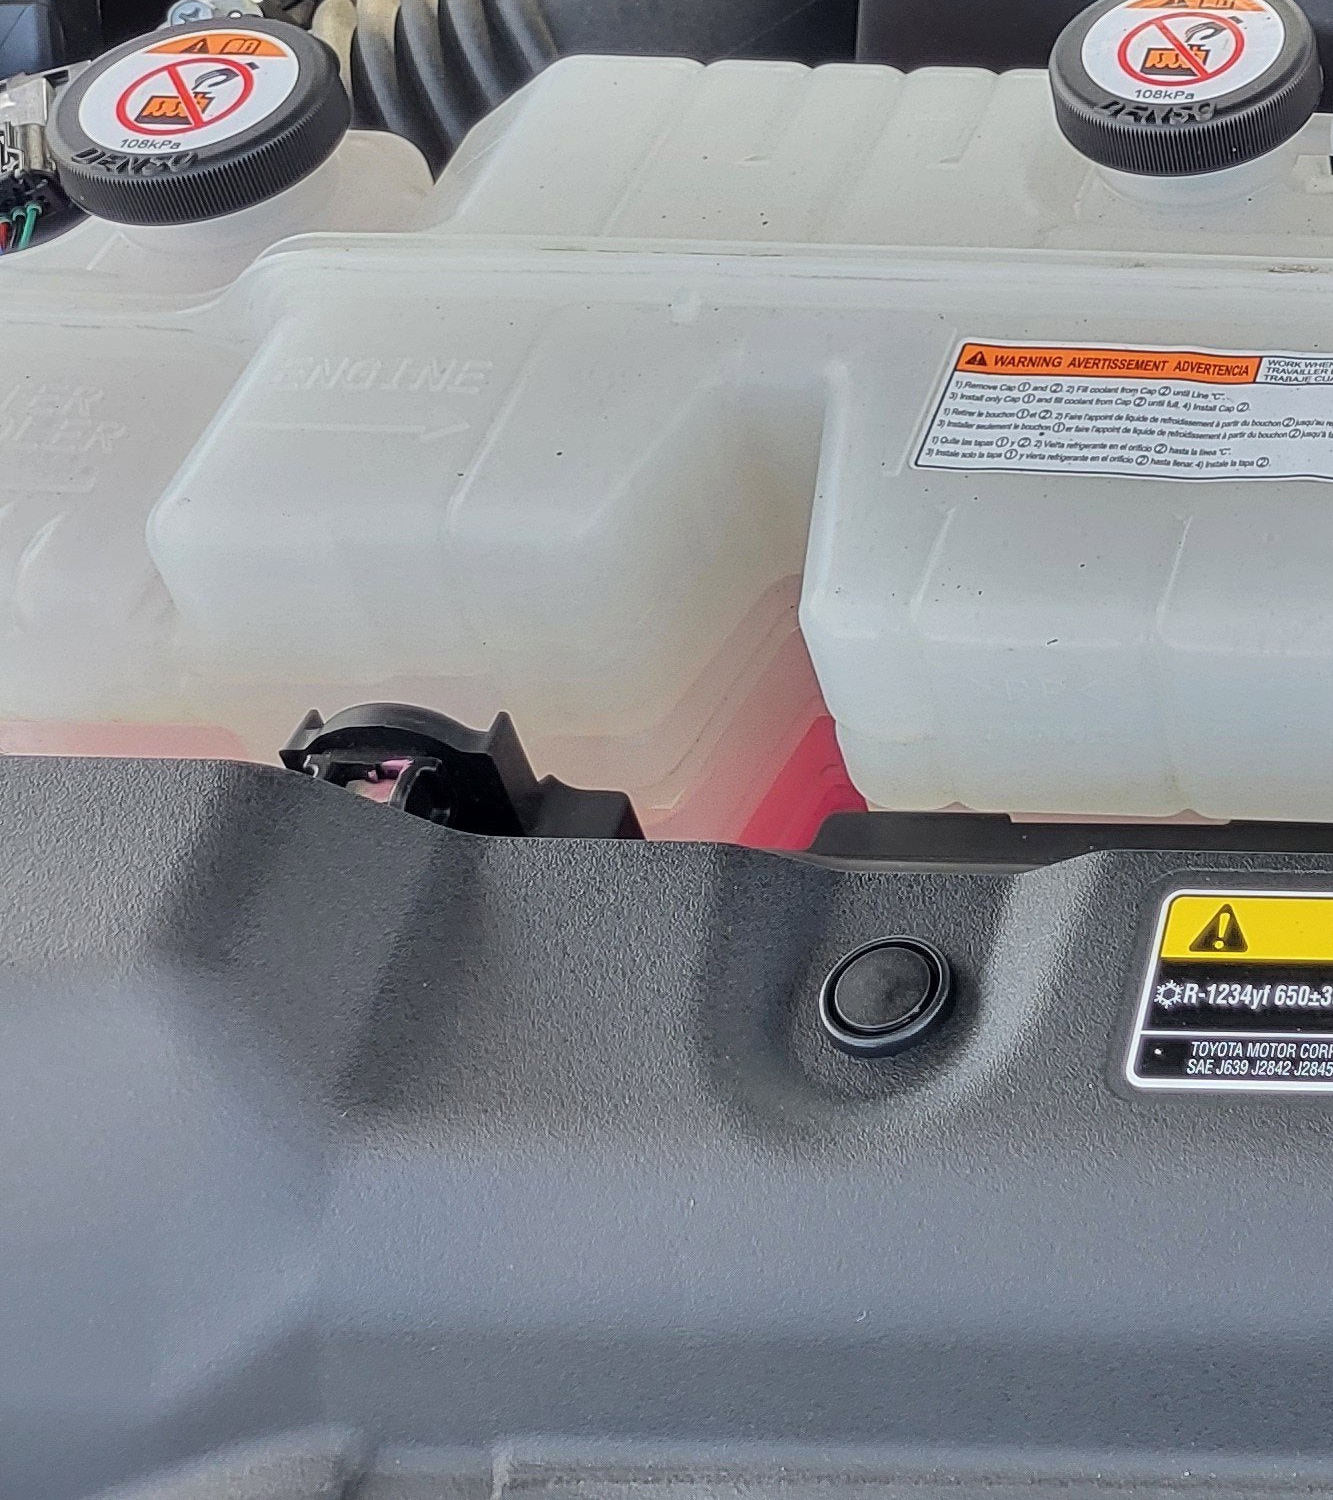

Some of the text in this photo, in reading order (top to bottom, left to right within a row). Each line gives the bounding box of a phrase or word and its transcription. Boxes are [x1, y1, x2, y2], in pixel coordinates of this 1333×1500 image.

[1134, 89, 1195, 100] 108kPa
[1094, 100, 1217, 125] DENSO
[119, 138, 182, 150] 108kPa
[71, 147, 200, 174] DENSO
[994, 355, 1249, 376] WARNING AVERTISSEMENT ADVERTENCIA
[1266, 367, 1328, 375] TRAVAILLER
[1268, 360, 1301, 368] WORK
[276, 356, 493, 395] ENGINE
[964, 382, 998, 391] Remove
[1000, 384, 1016, 392] Cap
[1090, 386, 1119, 394] coolant
[1140, 388, 1157, 396] Cap
[1192, 391, 1209, 399] Line
[960, 393, 983, 402] Install
[985, 395, 1001, 404] only
[1115, 399, 1131, 407] Cap
[1193, 403, 1217, 412] Install
[1219, 405, 1235, 413] Cap
[1183, 983, 1270, 1009] R-1234yf
[1191, 1041, 1244, 1058] TOYOTA
[1246, 1042, 1296, 1058] MOTOR
[1186, 1059, 1215, 1075] SAE
[1215, 1060, 1249, 1076] J639
[1251, 1060, 1293, 1076] J2842
